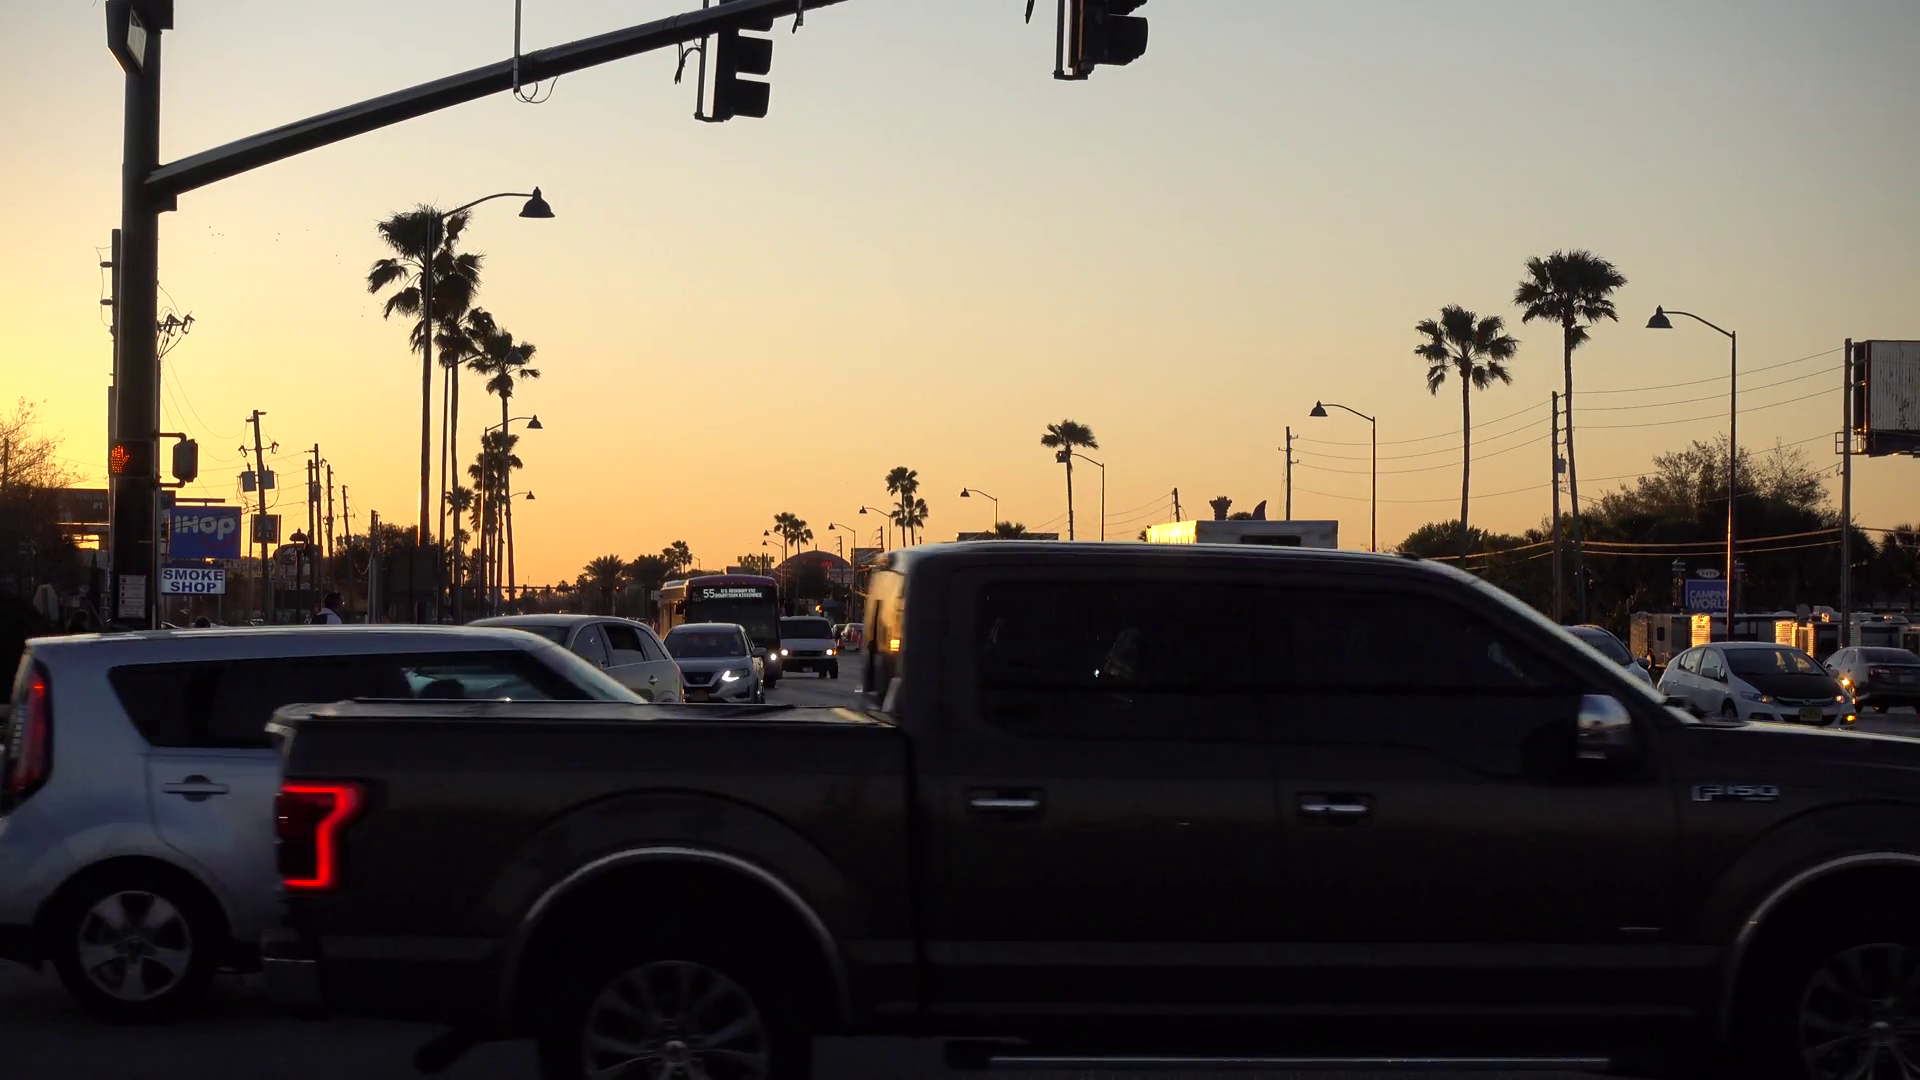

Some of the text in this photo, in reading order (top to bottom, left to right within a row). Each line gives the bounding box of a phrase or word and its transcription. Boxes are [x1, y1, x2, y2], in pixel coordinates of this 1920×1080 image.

[163, 569, 224, 581] SMOKE
[170, 581, 217, 593] SHOP
[703, 588, 715, 599] 55
[1689, 590, 1727, 599] CAMPIN
